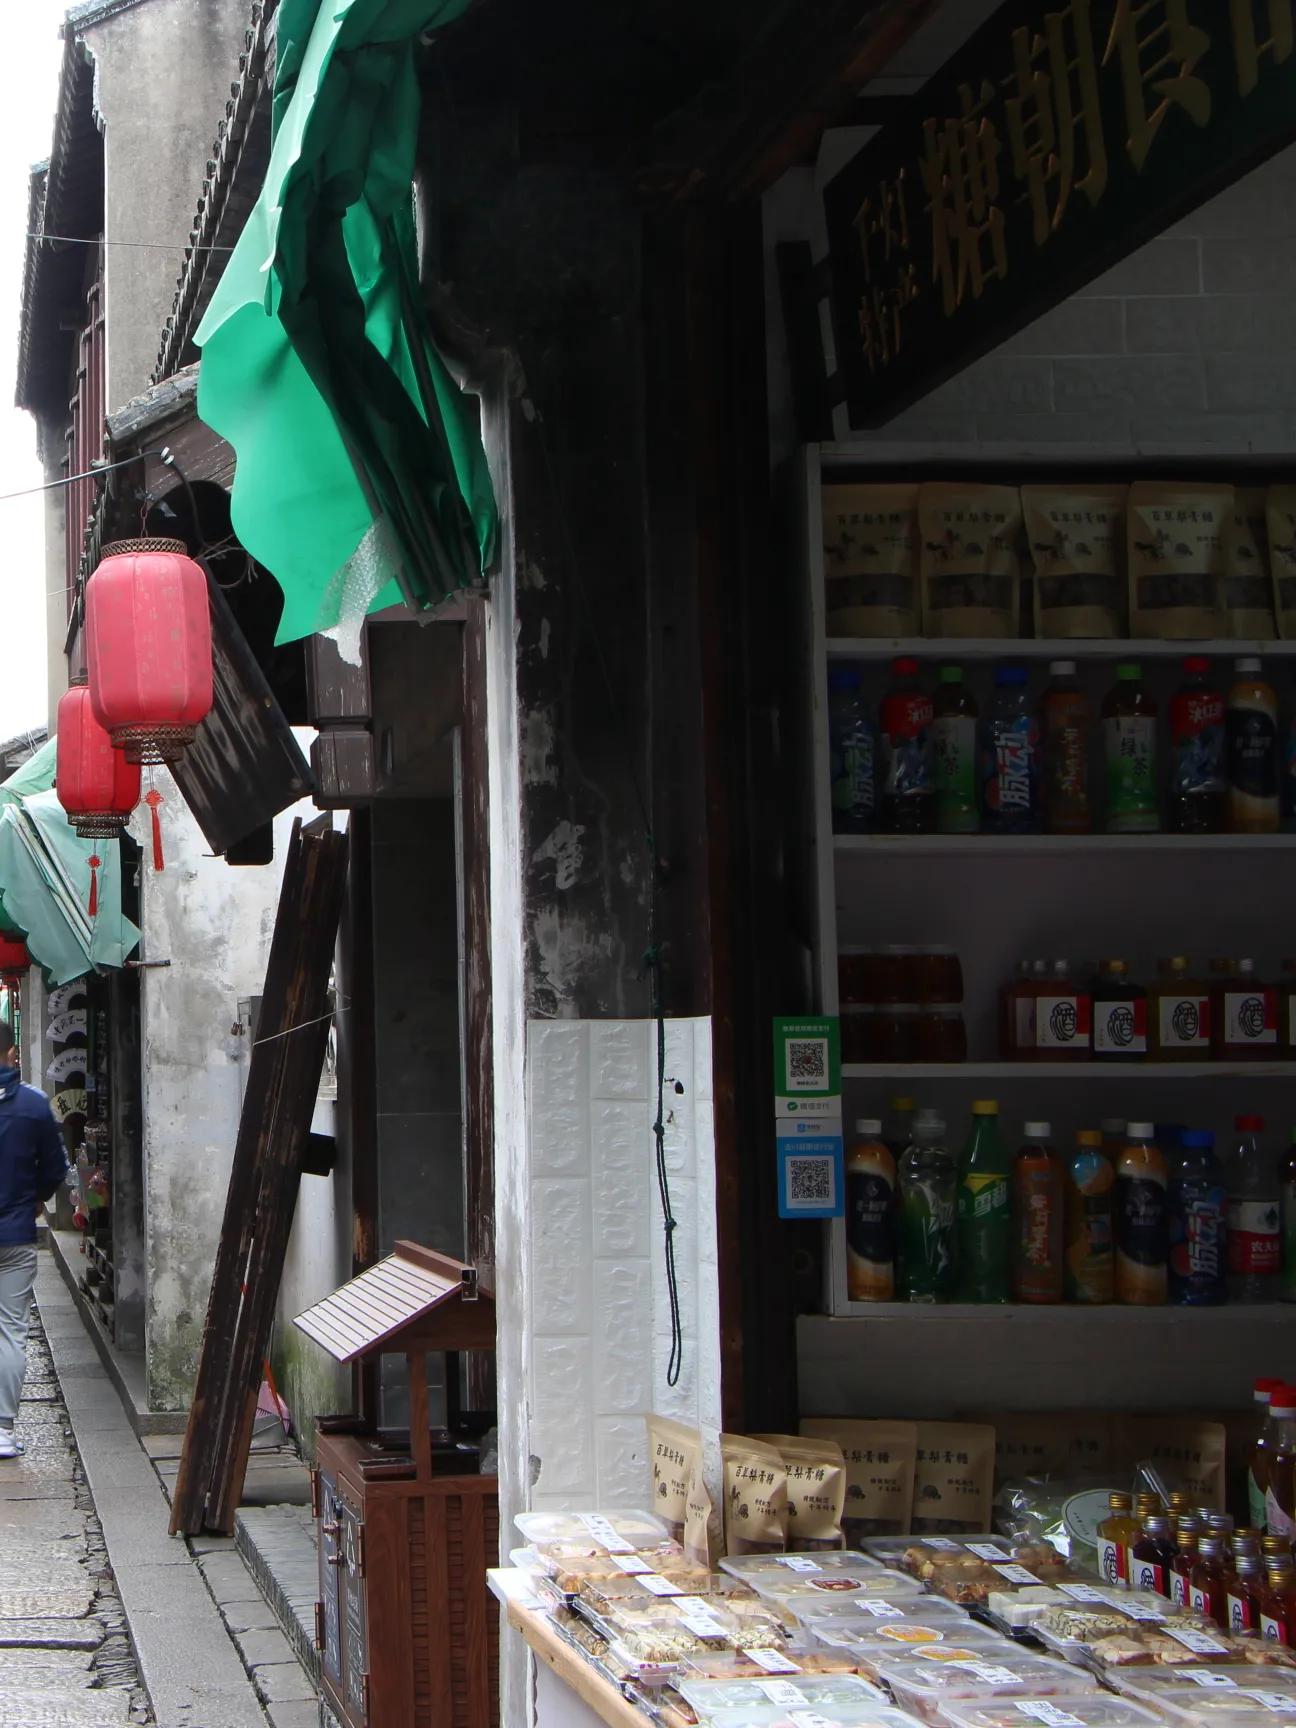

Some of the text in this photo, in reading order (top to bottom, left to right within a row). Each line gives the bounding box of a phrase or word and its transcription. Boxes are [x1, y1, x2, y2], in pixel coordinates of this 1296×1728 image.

[735, 1465, 775, 1486] 百草梨膏糖
